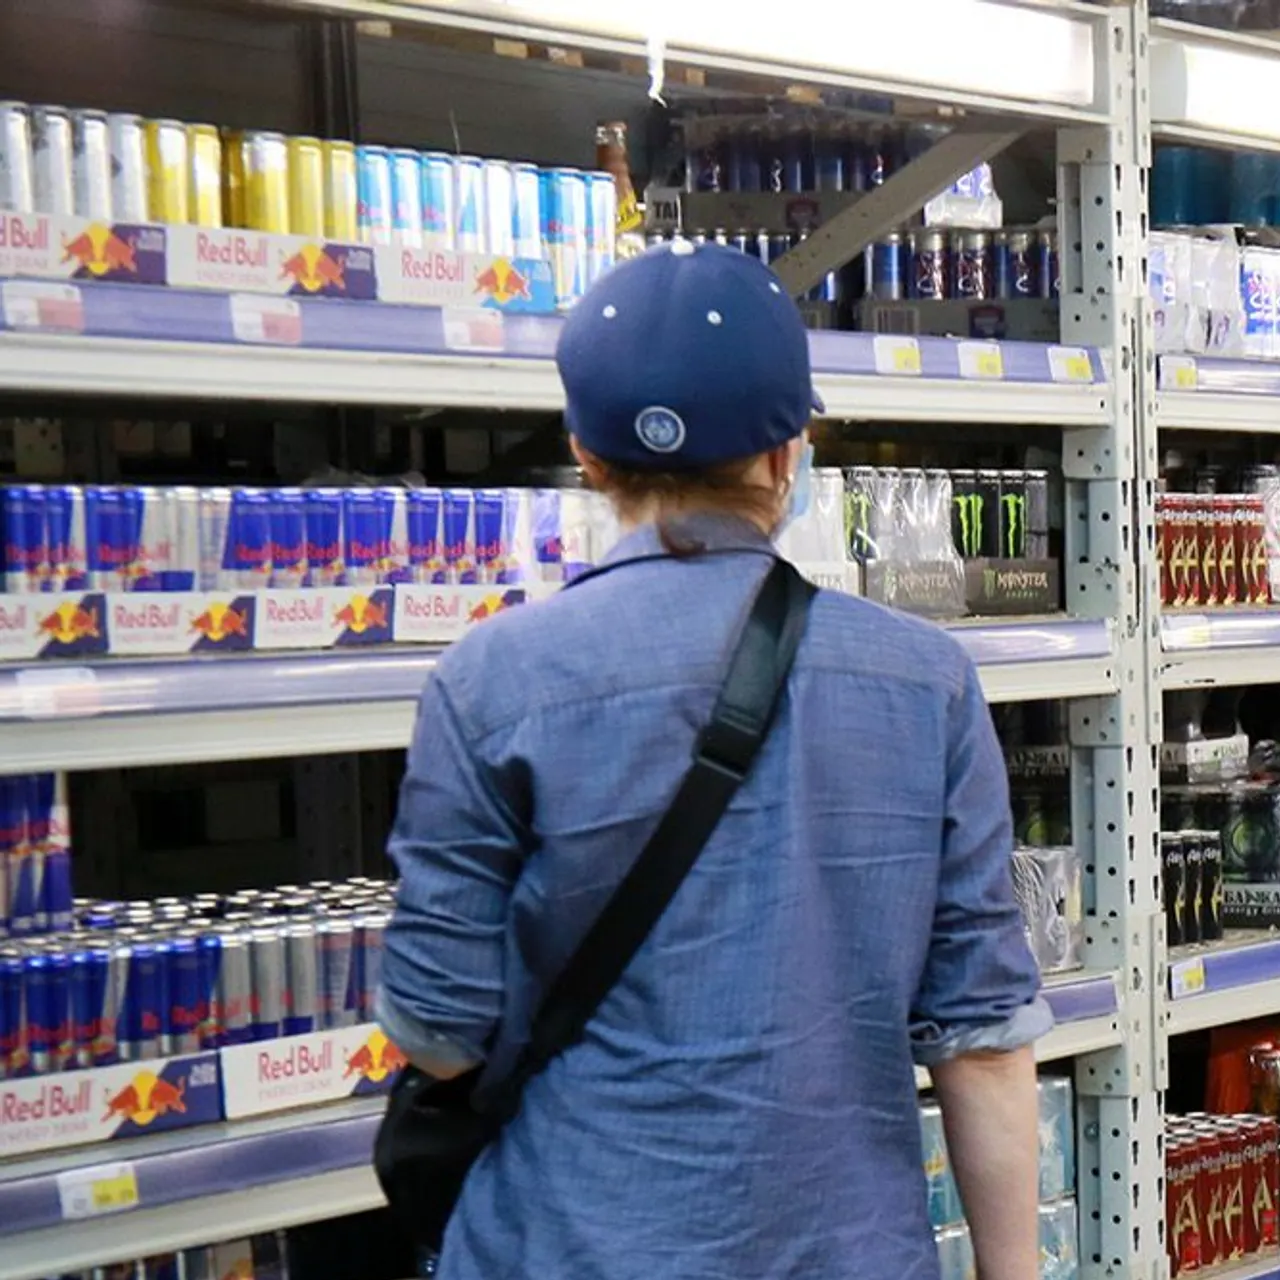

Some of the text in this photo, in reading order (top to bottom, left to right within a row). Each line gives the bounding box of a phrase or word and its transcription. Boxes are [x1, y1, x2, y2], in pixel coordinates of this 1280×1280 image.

[10, 217, 48, 249] Bull
[197, 231, 268, 267] Red Bull
[402, 252, 464, 282] Red Bull
[997, 569, 1048, 590] MONSTER
[114, 603, 180, 629] Red Bull
[266, 596, 325, 623] Red Bull
[404, 593, 460, 617] Red Bull
[259, 1041, 334, 1083] Red Bull
[2, 1078, 92, 1124] Red Bull
